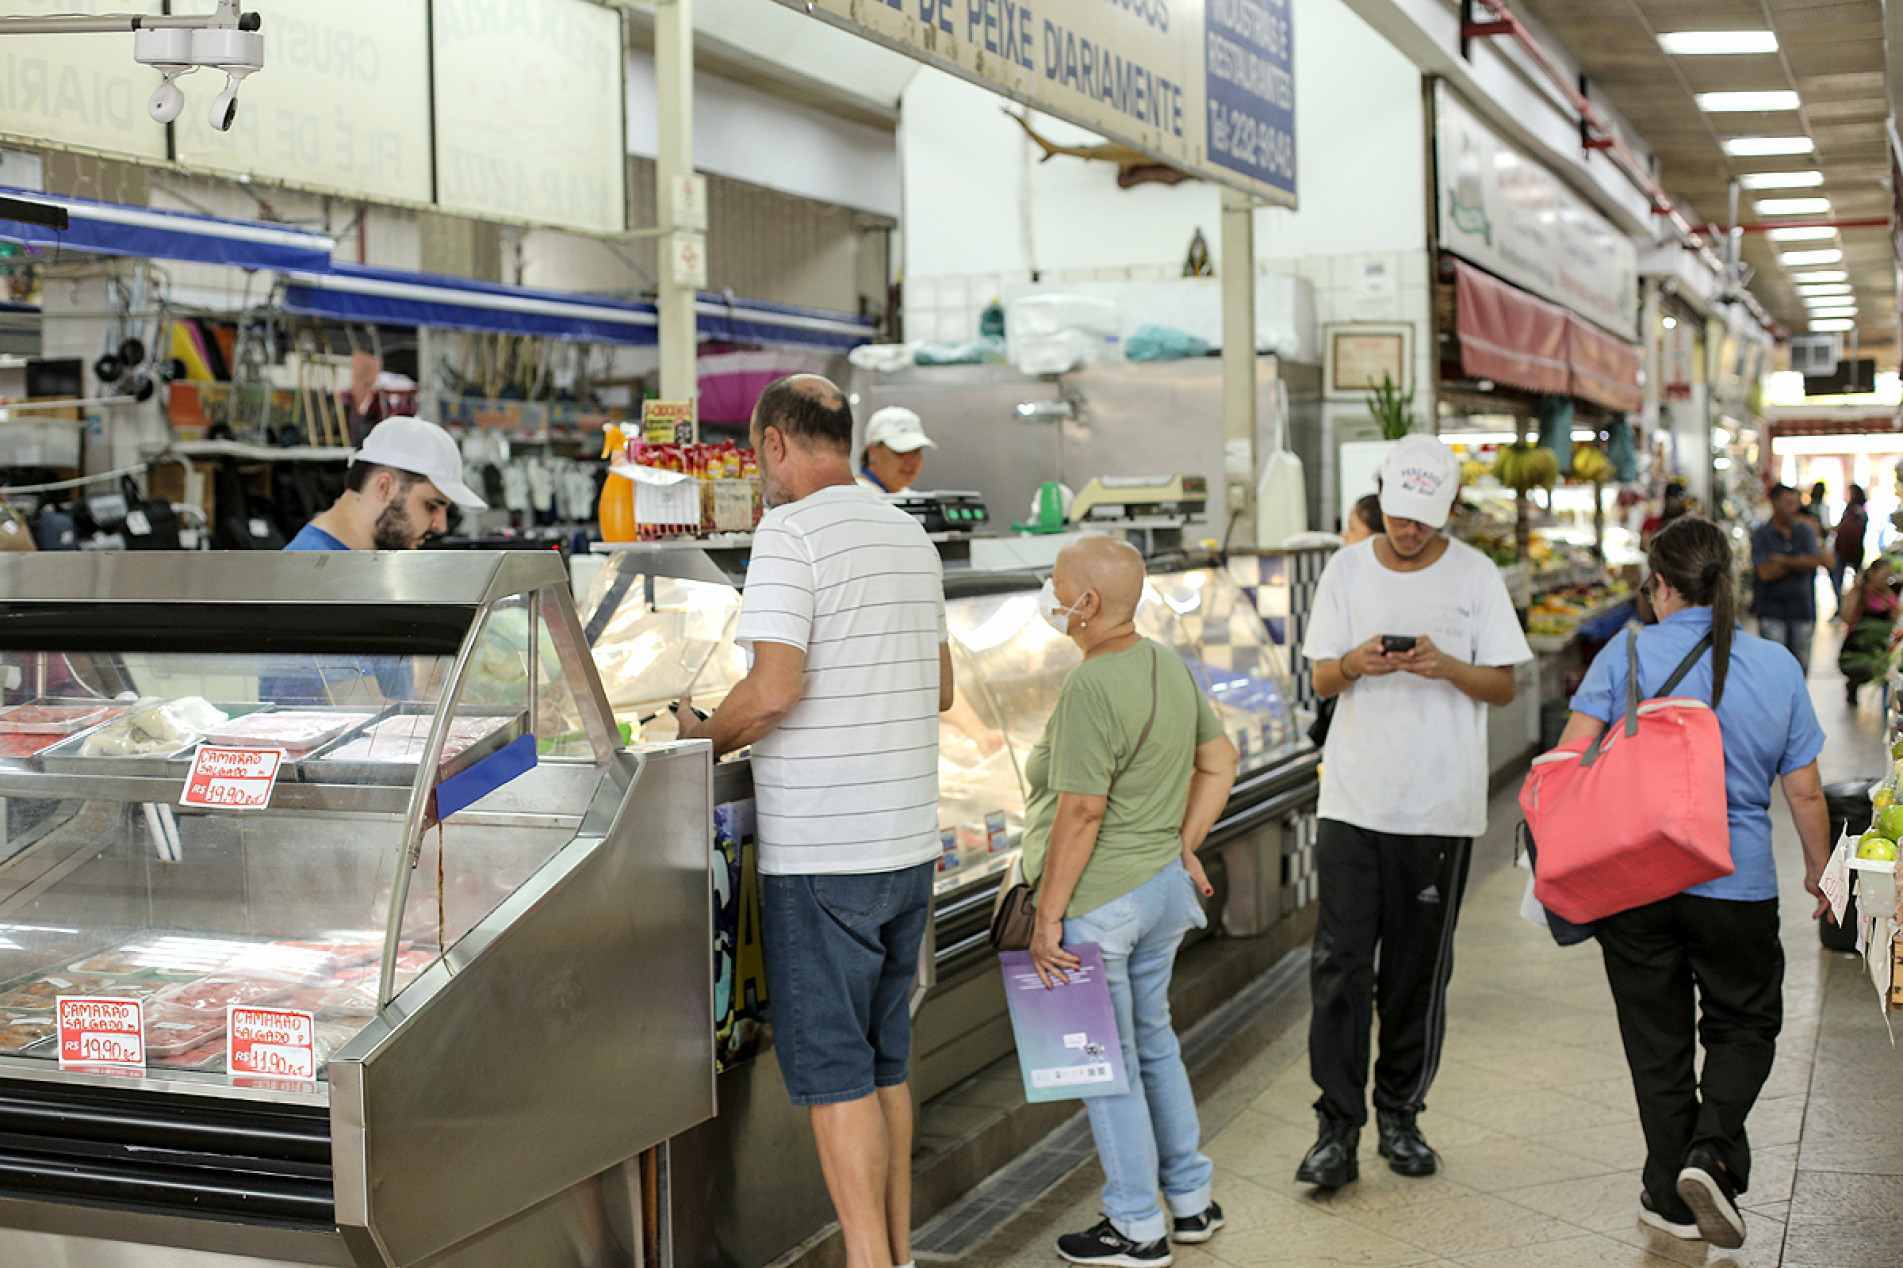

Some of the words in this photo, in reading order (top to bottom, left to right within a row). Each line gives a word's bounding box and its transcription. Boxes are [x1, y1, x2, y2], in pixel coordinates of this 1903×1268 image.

[967, 0, 1034, 71] PEIXE
[1044, 19, 1183, 137] DIARIAMENTE
[65, 1018, 123, 1030] SALGADO
